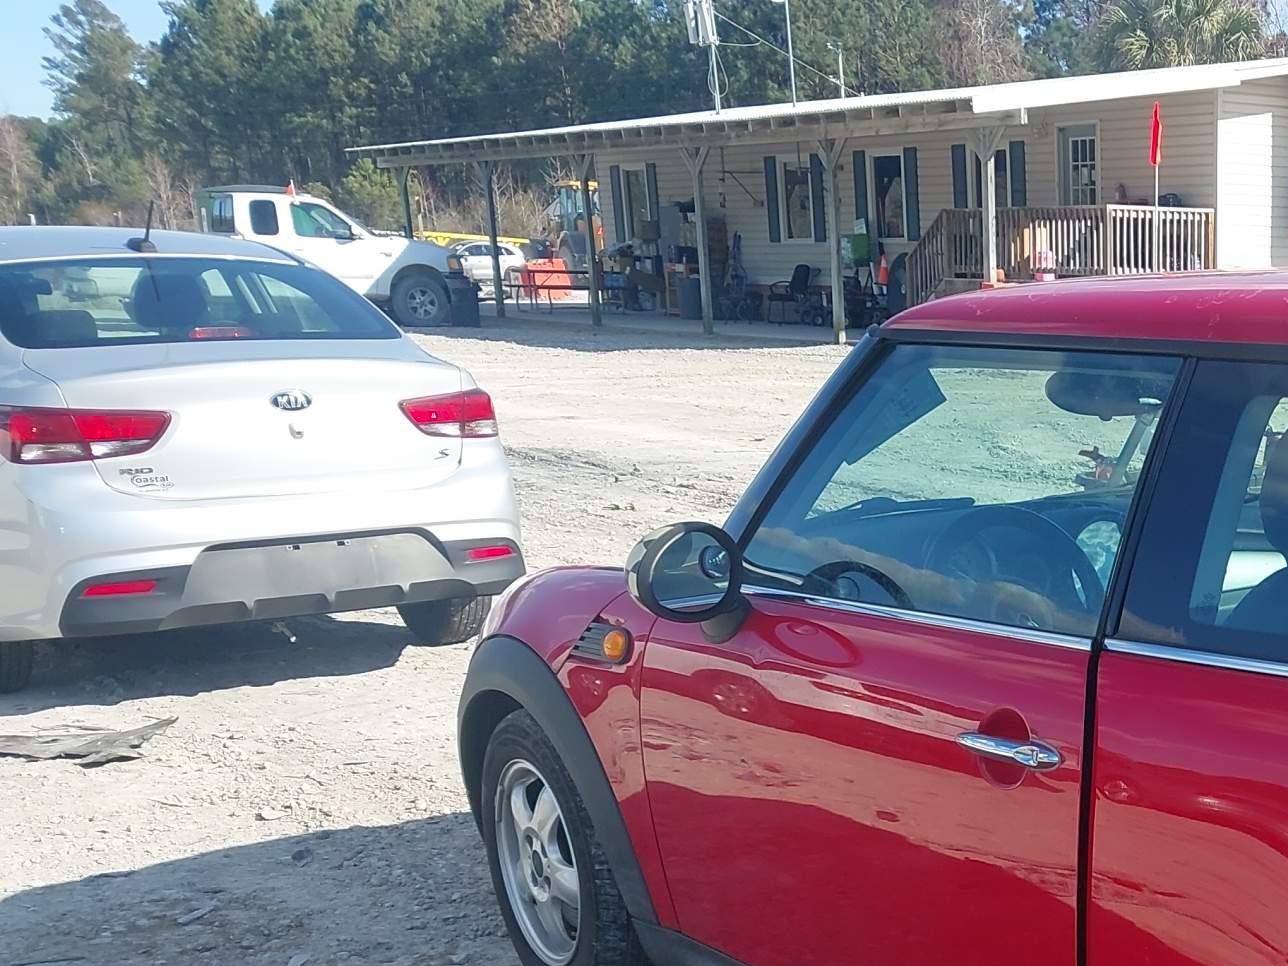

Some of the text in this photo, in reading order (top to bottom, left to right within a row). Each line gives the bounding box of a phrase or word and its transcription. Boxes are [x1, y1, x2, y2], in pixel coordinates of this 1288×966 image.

[276, 393, 309, 409] KIA
[434, 448, 449, 460] S
[119, 467, 153, 475] RIO
